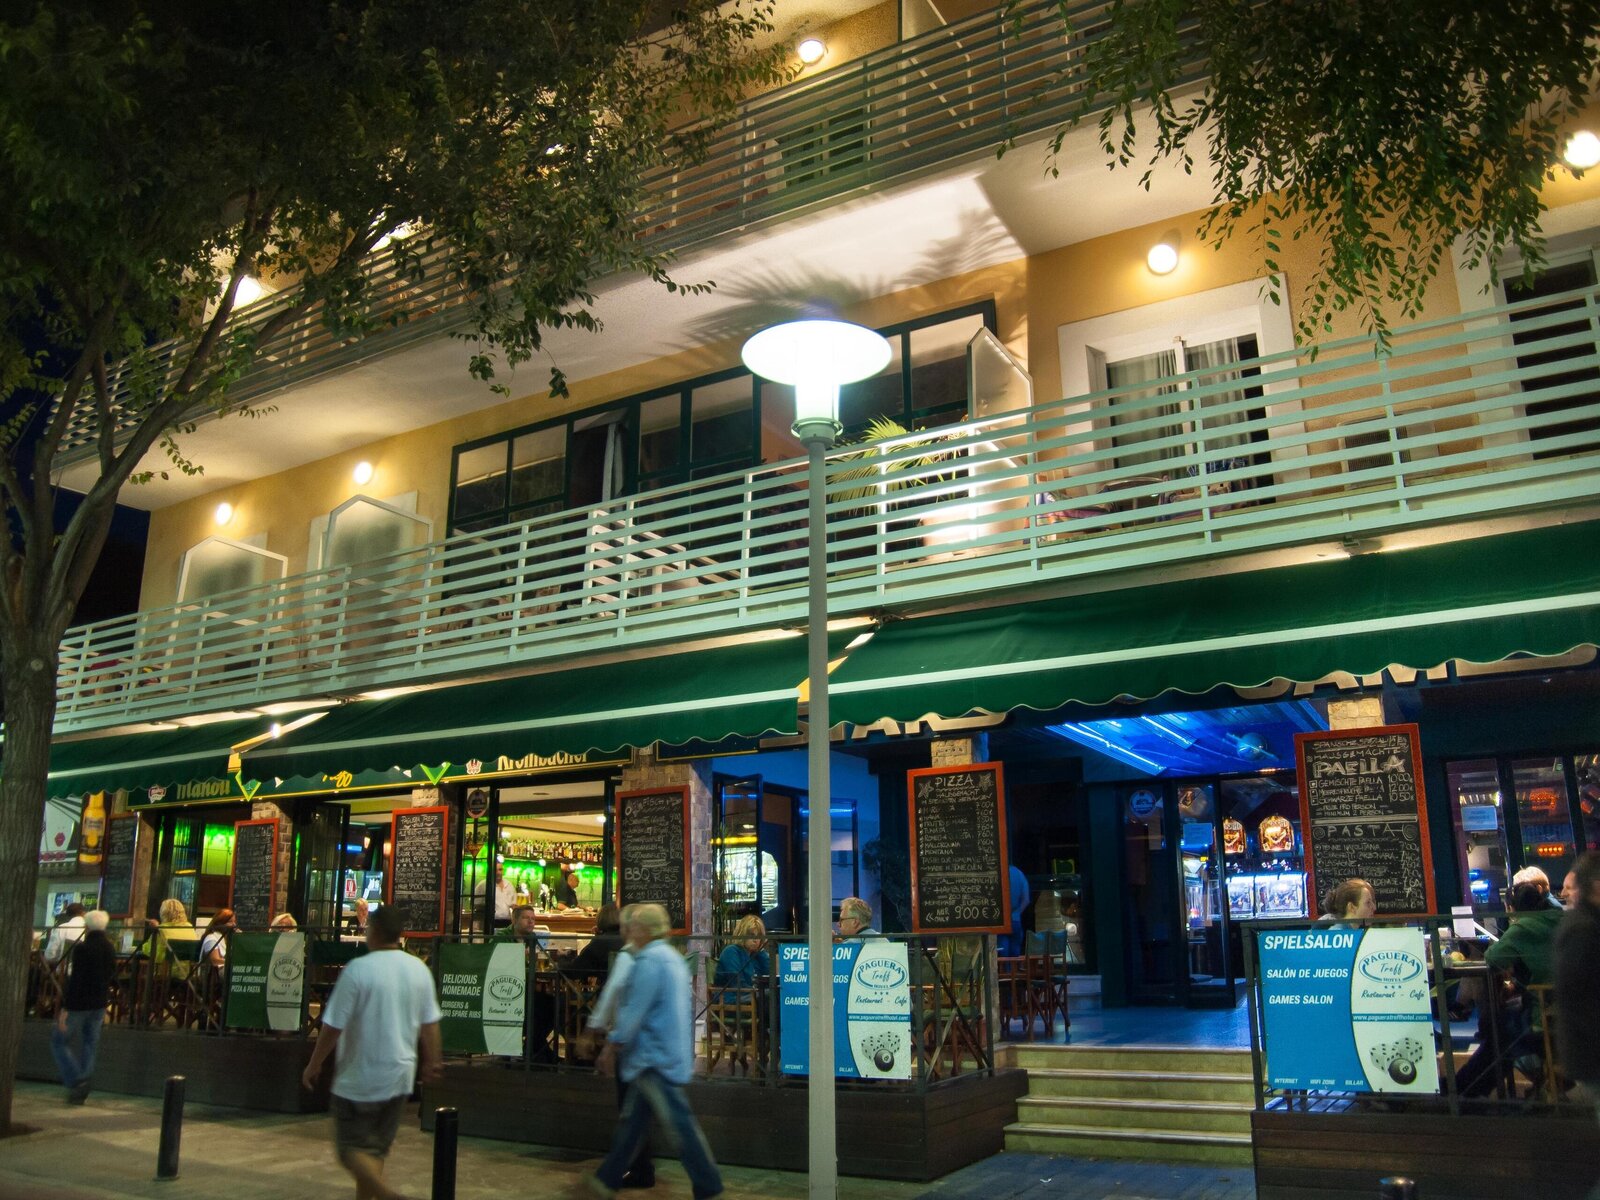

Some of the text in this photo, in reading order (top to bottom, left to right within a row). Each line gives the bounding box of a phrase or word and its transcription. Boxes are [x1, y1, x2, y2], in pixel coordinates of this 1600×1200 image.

[1313, 755, 1405, 778] PAELLA
[935, 773, 974, 787] PIZZA
[1328, 824, 1396, 838] PASTA
[1264, 934, 1354, 950] SPIELSALON
[1362, 952, 1416, 967] PAGUERA
[859, 960, 902, 974] PAGUERA
[1380, 963, 1404, 976] Treff
[784, 973, 808, 983] SALÓN
[872, 970, 891, 982] Treff
[1266, 968, 1348, 978] SALÓN DE JUEGOS
[443, 974, 478, 984] DELICIOUS
[490, 976, 522, 989] PAGUERA
[442, 985, 482, 996] HOMEMADE
[1361, 989, 1396, 998] Restaurant
[784, 997, 810, 1006] GAMES
[855, 995, 884, 1004] Restaurant
[1268, 994, 1334, 1004] GAMES SALON
[441, 1000, 469, 1010] BURGERS &
[452, 1010, 468, 1018] SPARE
[468, 1010, 482, 1018] RIBS
